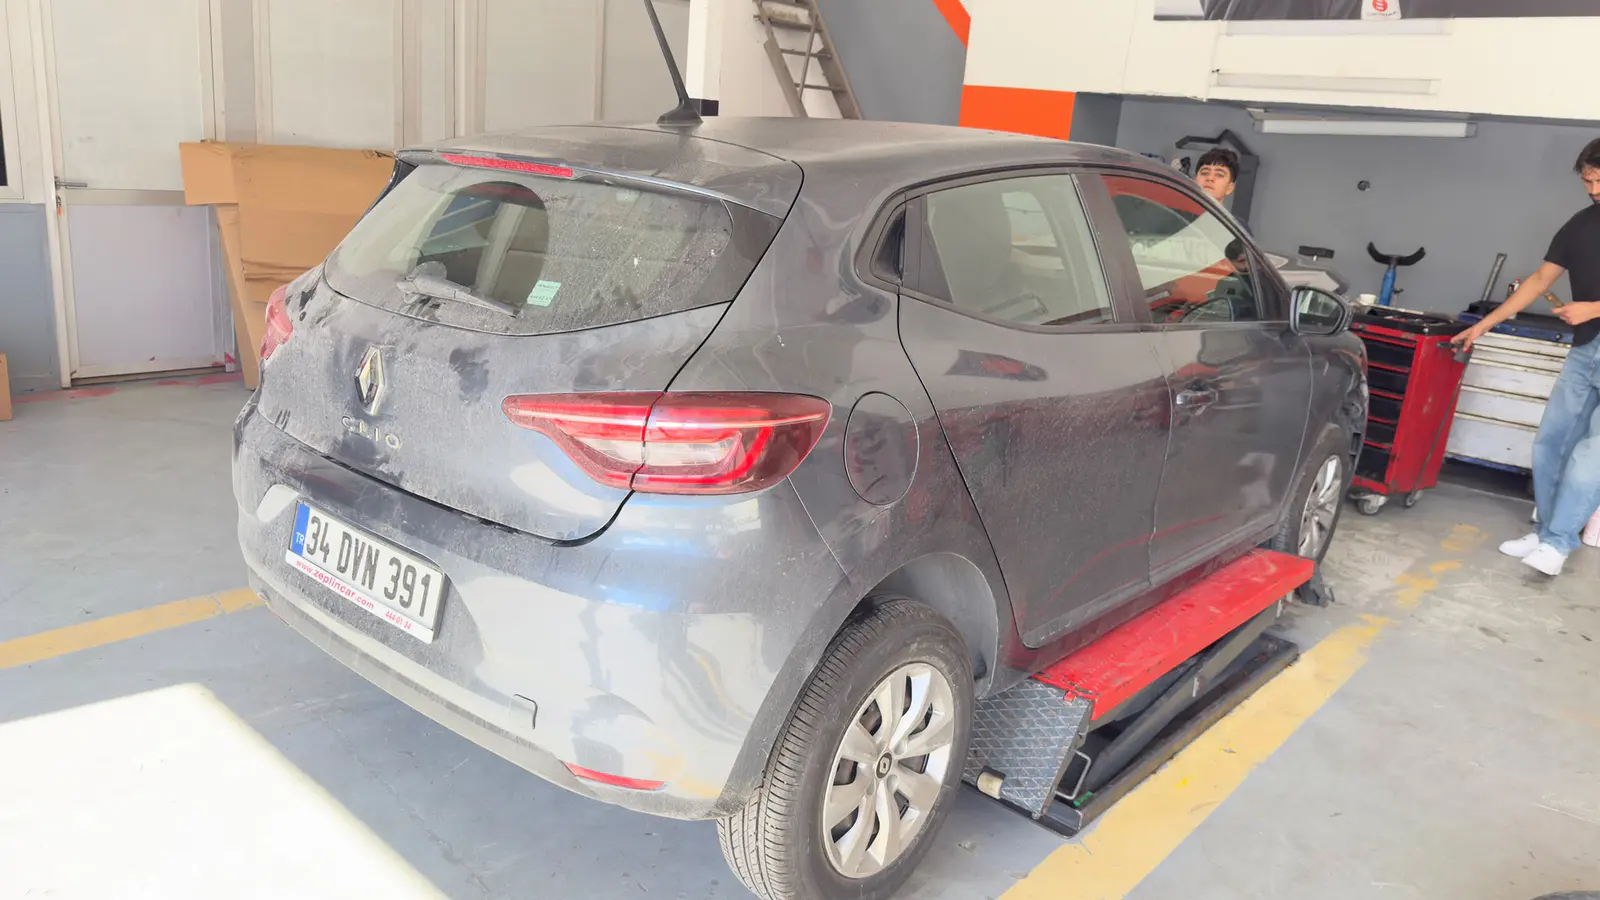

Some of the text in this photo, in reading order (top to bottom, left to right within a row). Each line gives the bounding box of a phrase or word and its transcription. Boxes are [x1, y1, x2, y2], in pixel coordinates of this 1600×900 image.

[341, 415, 402, 449] CLIO
[295, 531, 305, 546] TR
[296, 559, 374, 609] www.zeplincar.com
[306, 515, 431, 616] 34 DVN 391
